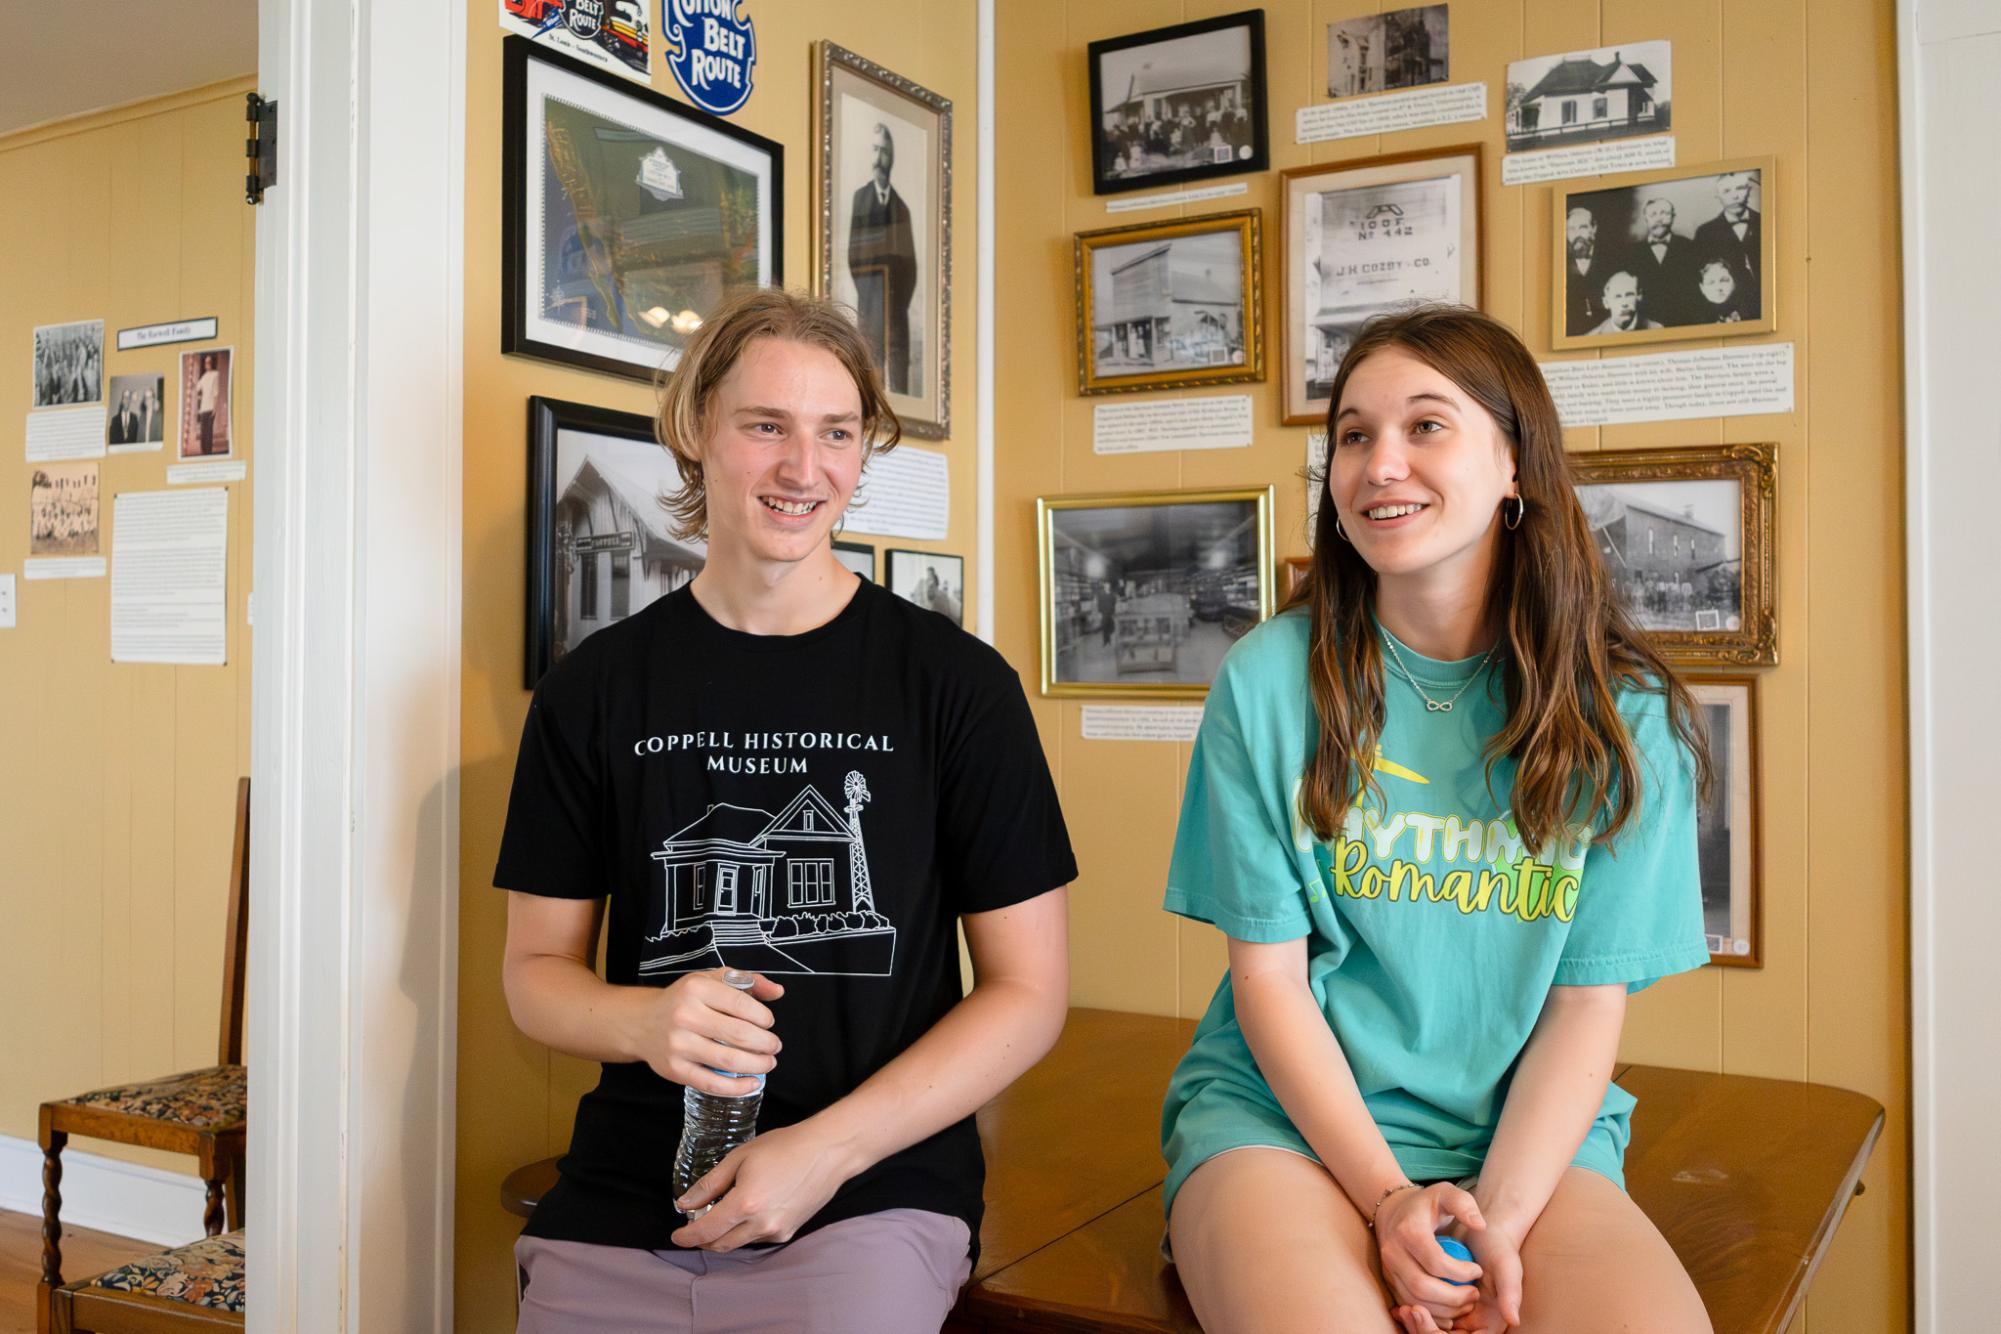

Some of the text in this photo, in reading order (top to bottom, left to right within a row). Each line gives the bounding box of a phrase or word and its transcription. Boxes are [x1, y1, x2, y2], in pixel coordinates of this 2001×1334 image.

[570, 9, 597, 31] ROUTE
[702, 17, 746, 60] BELT
[691, 48, 742, 91] ROUTE
[634, 731, 894, 756] COPPELL HISTORICAL
[706, 755, 808, 774] MUSEUM
[1329, 836, 1580, 923] Romantic
